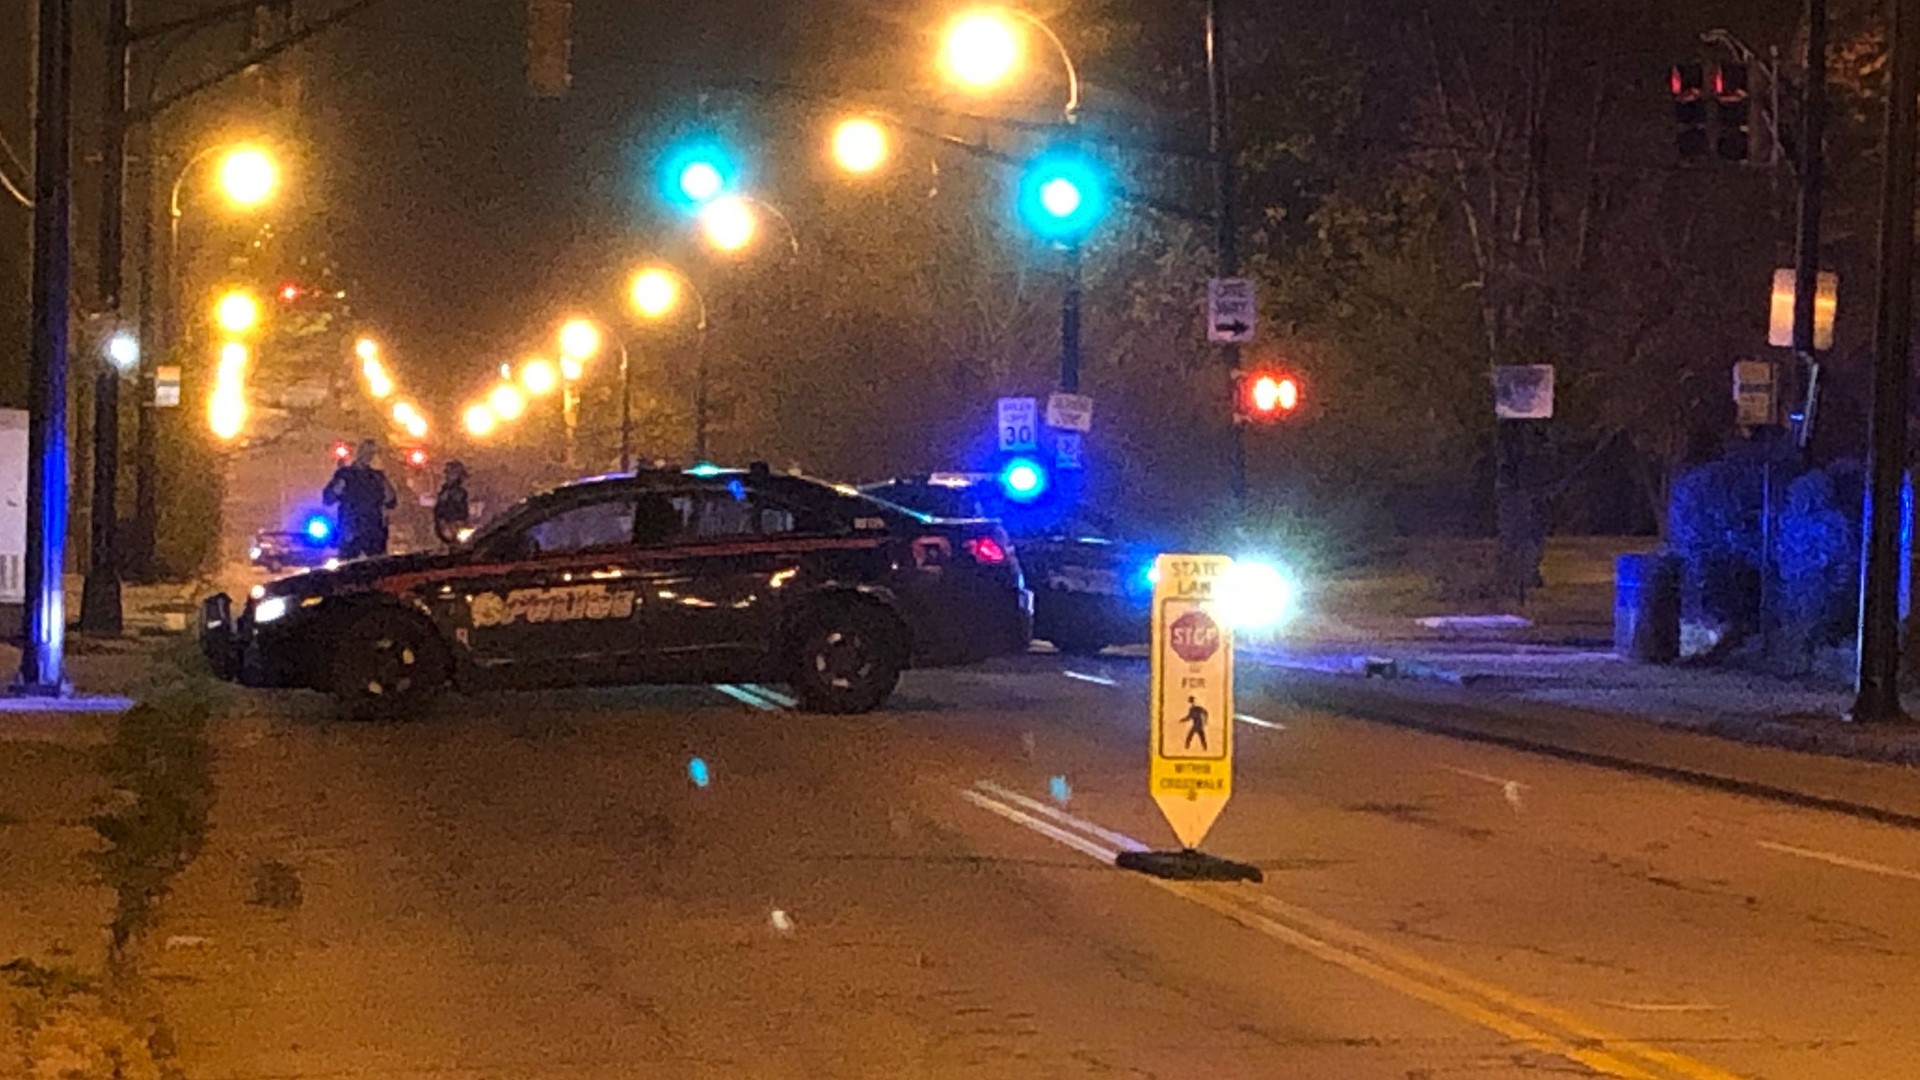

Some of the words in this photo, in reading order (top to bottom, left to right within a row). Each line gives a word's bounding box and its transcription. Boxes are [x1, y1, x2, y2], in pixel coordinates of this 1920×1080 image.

[1004, 426, 1032, 446] 30
[1171, 562, 1219, 577] STATE
[1173, 626, 1219, 645] STOP
[1181, 677, 1206, 688] FOR
